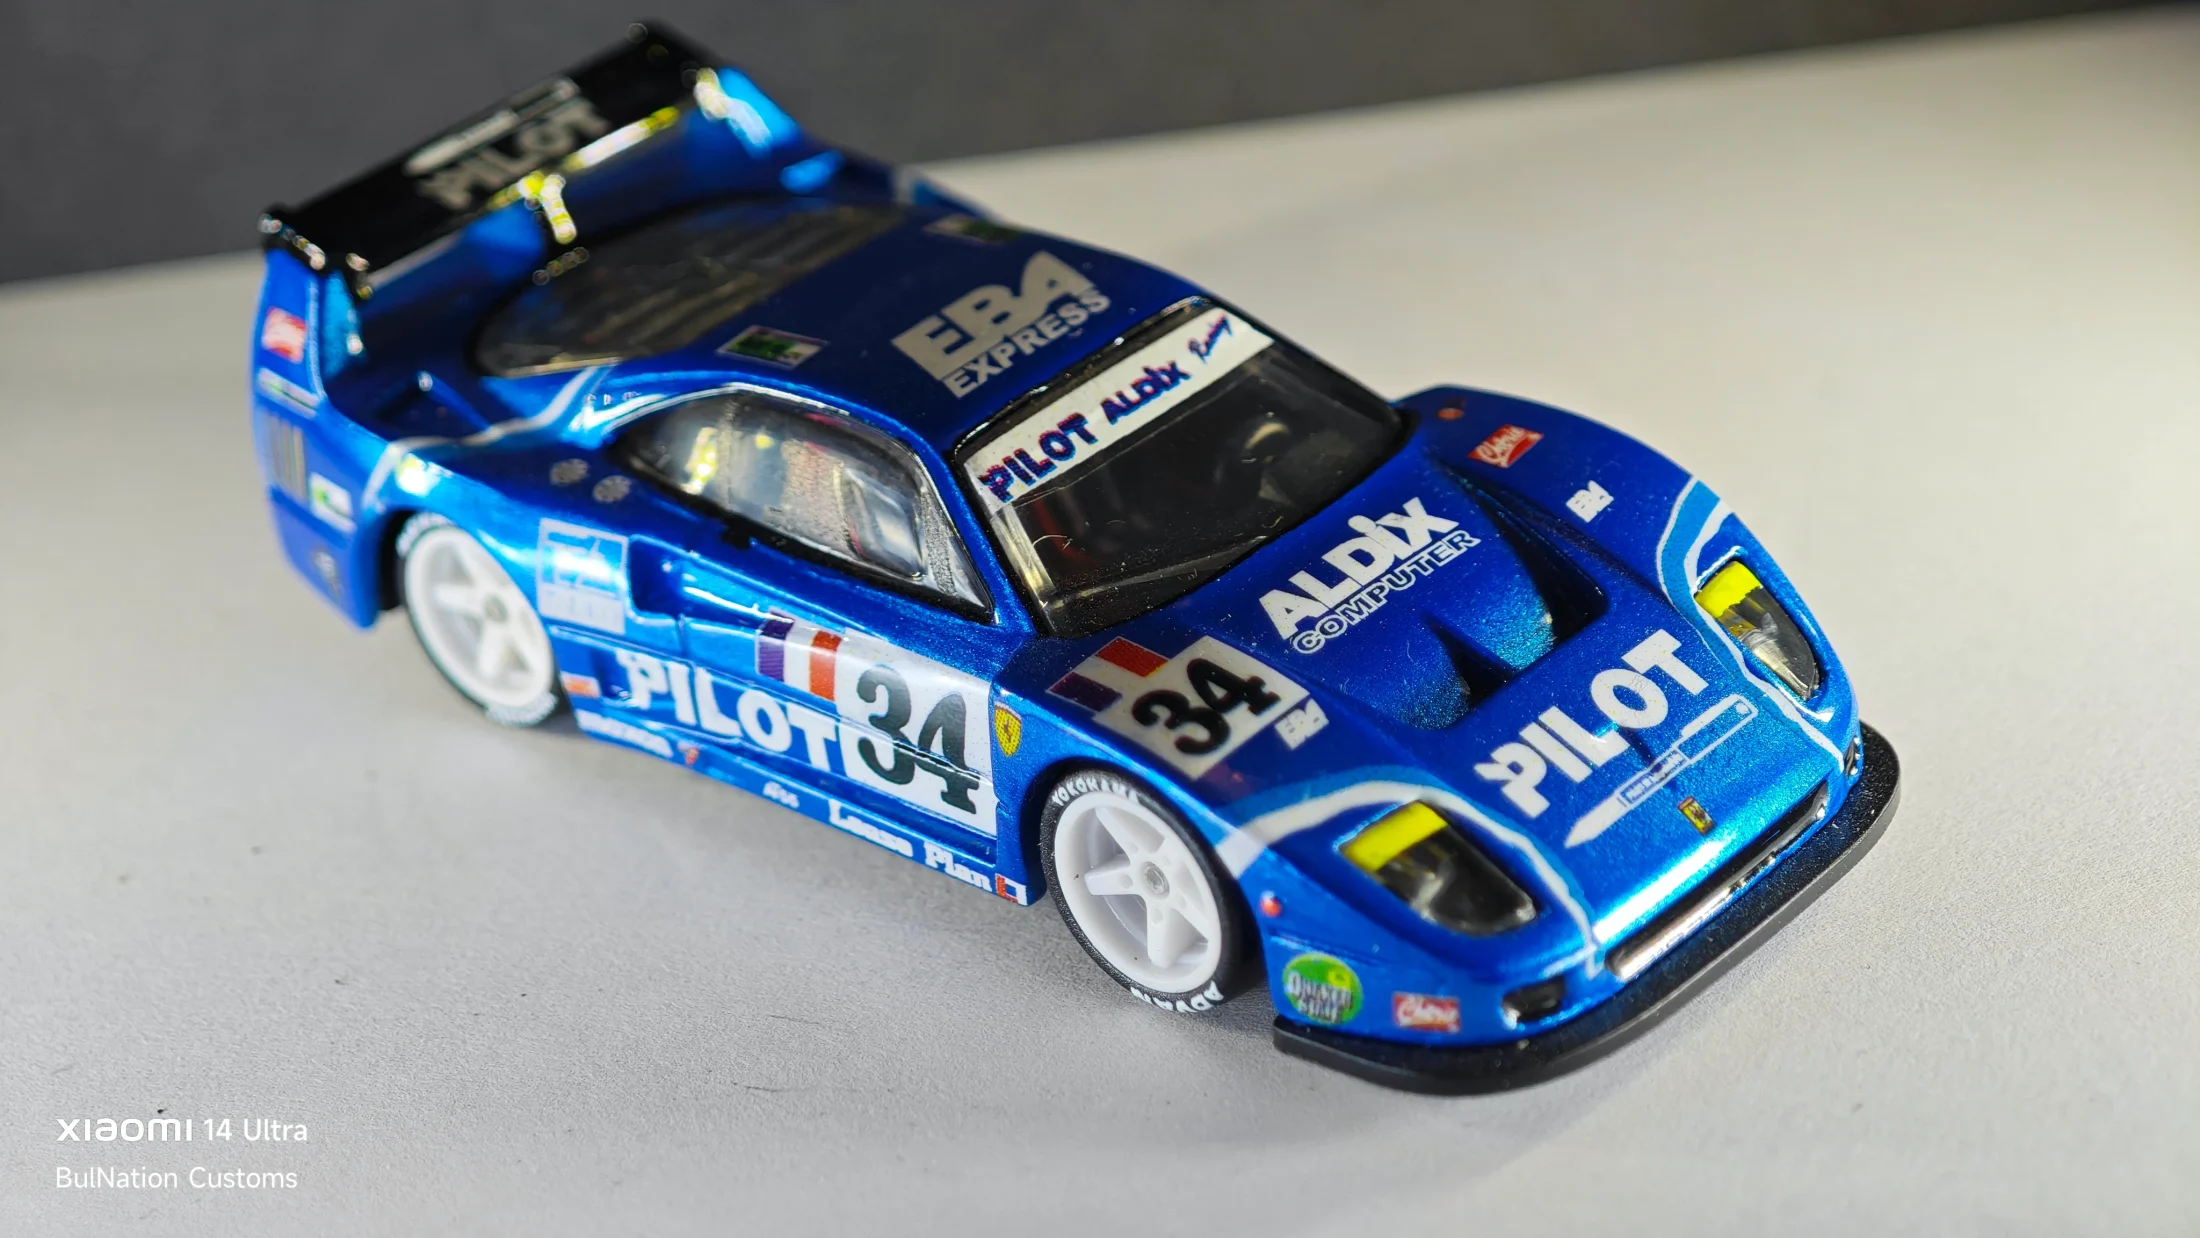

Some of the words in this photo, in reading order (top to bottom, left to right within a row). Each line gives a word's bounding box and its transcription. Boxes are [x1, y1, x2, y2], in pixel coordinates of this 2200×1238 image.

[891, 251, 1097, 381] EBA
[942, 287, 1111, 398] EXPRESS
[979, 413, 1099, 503] PILOT
[1293, 530, 1482, 654] COMPUTER
[616, 648, 838, 772] PILOT
[857, 665, 981, 814] 34
[1131, 658, 1283, 755] 34
[1474, 629, 1709, 818] PILOT
[924, 841, 993, 892] Plan
[1130, 980, 1224, 1013] ADVAN
